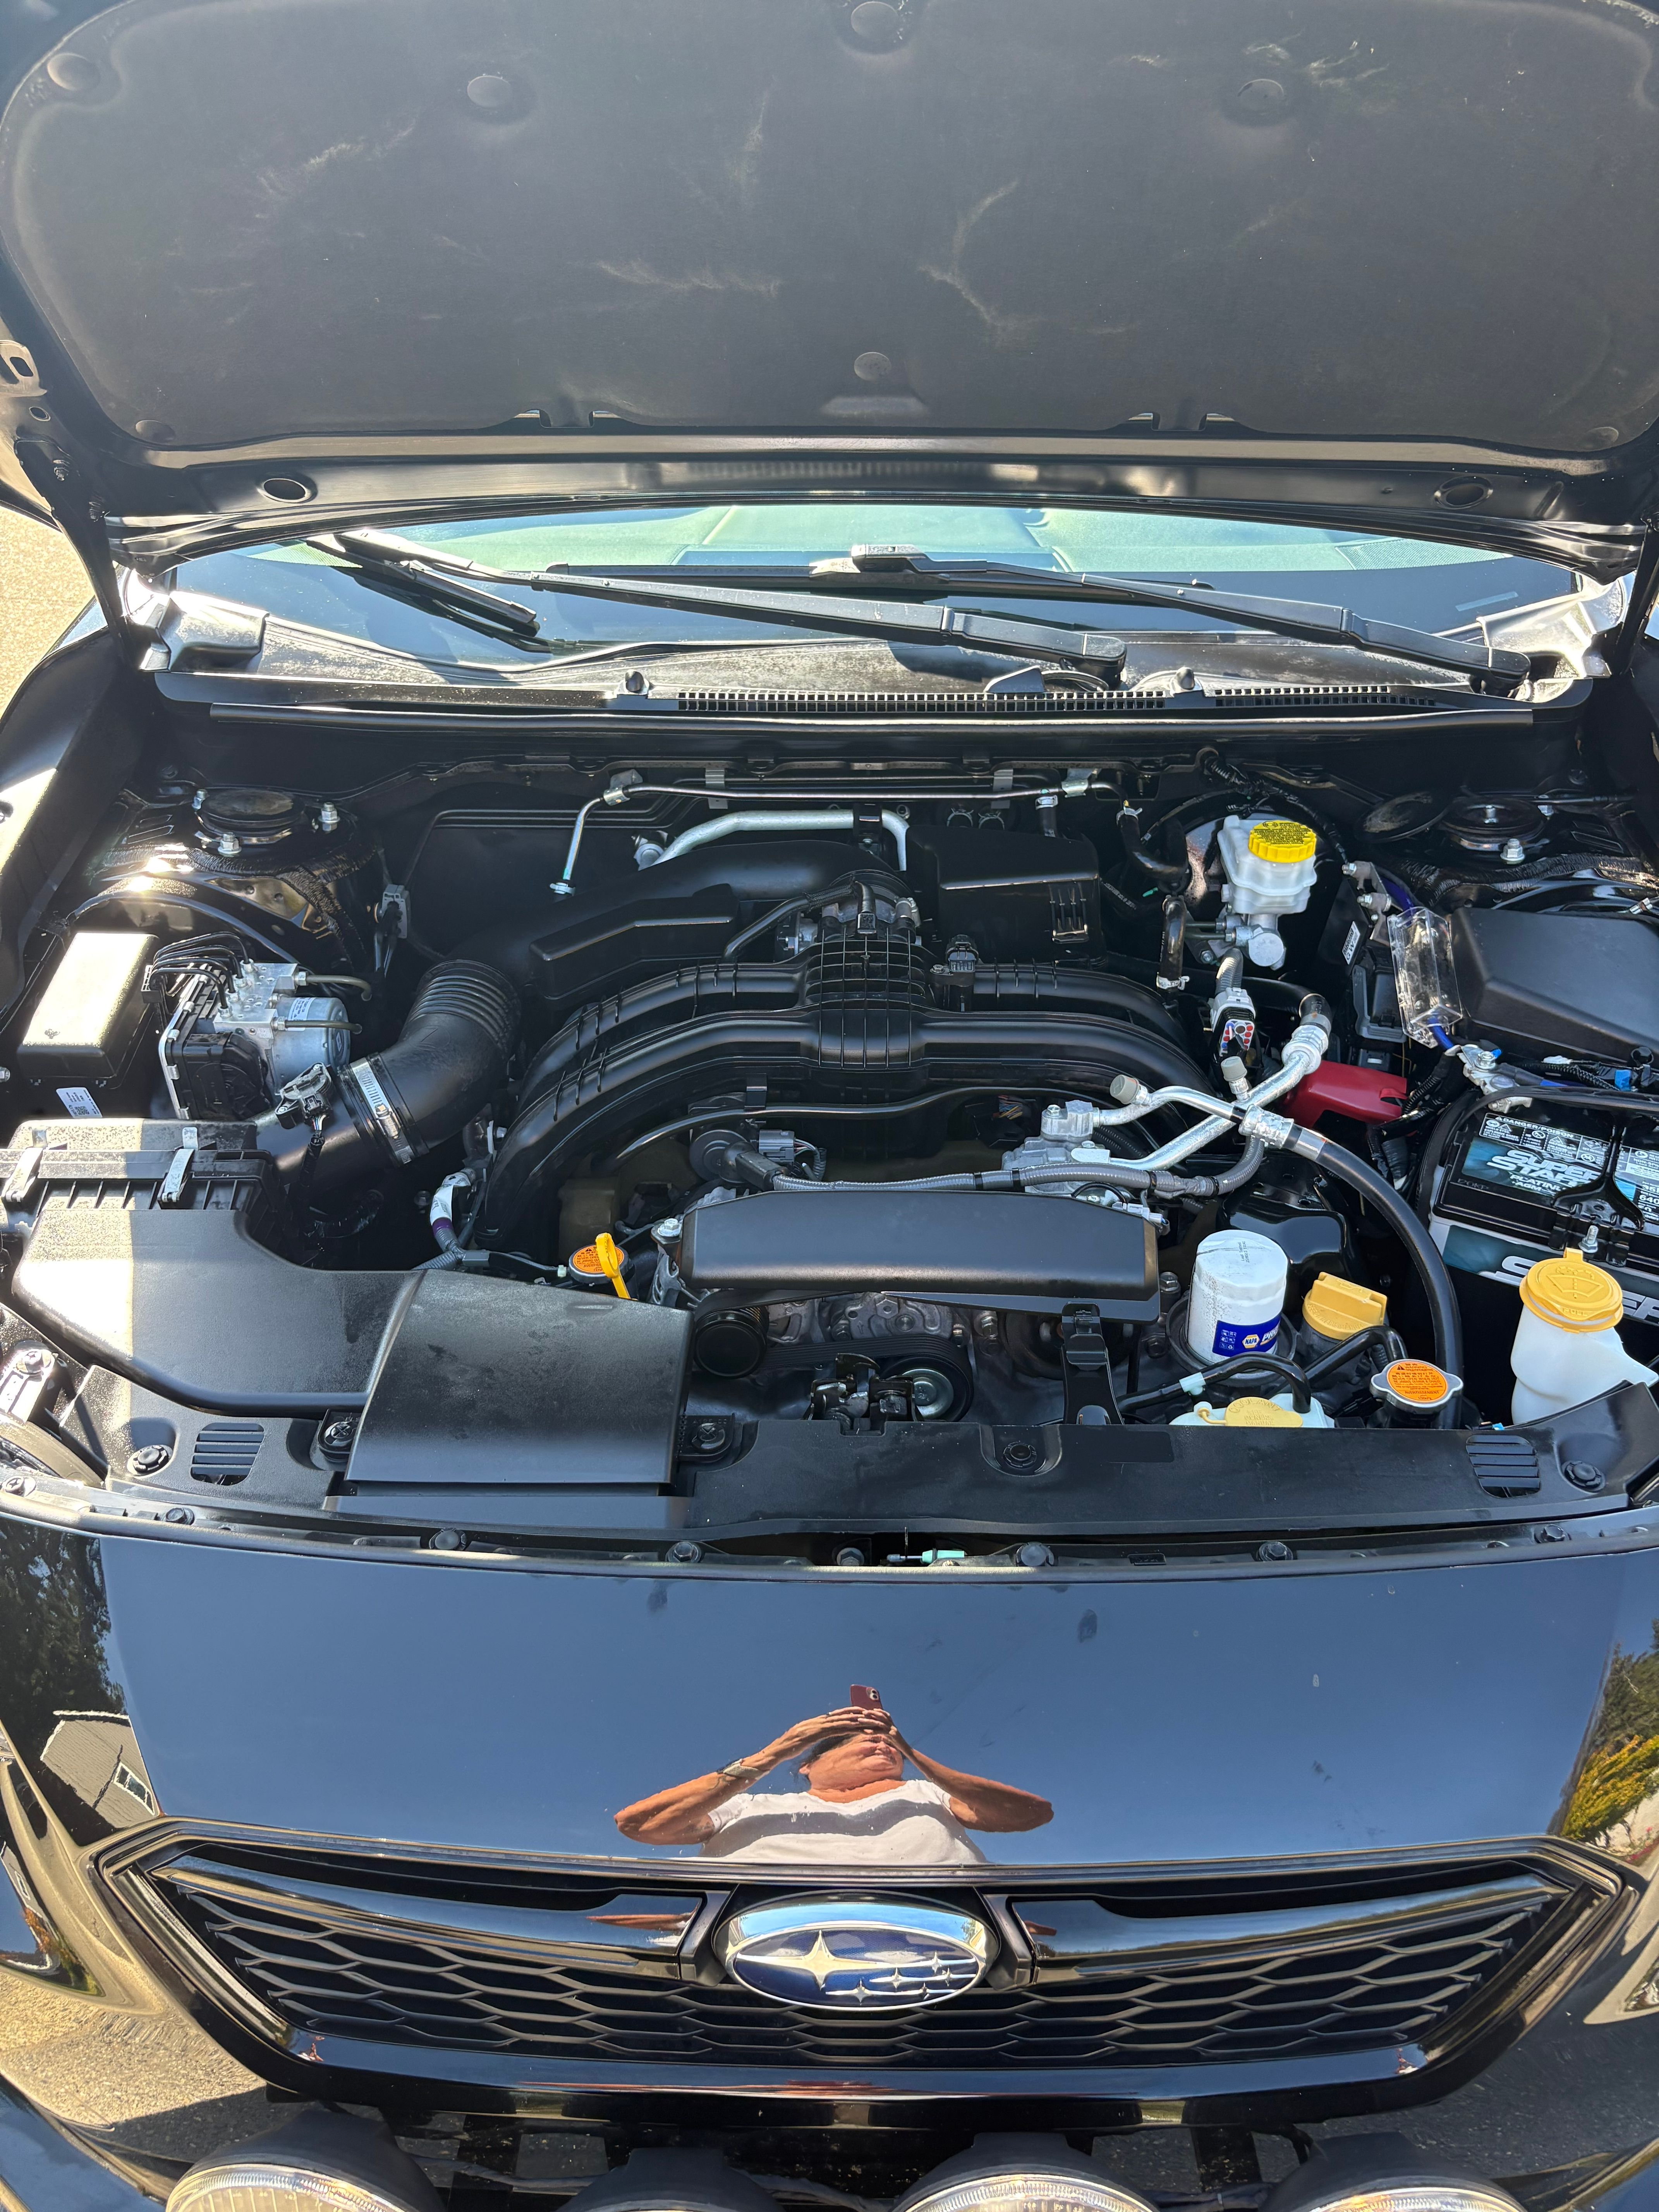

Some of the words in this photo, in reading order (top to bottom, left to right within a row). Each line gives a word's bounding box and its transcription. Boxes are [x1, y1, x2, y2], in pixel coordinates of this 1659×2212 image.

[1503, 1117, 1574, 1138] DANGER/POISON
[1510, 1174, 1566, 1191] PLATINU
[1515, 1182, 1542, 1191] AGM
[1639, 1194, 1659, 1204] 640
[1562, 1307, 1588, 1317] PULL
[1228, 1398, 1282, 1413] COOLANT
